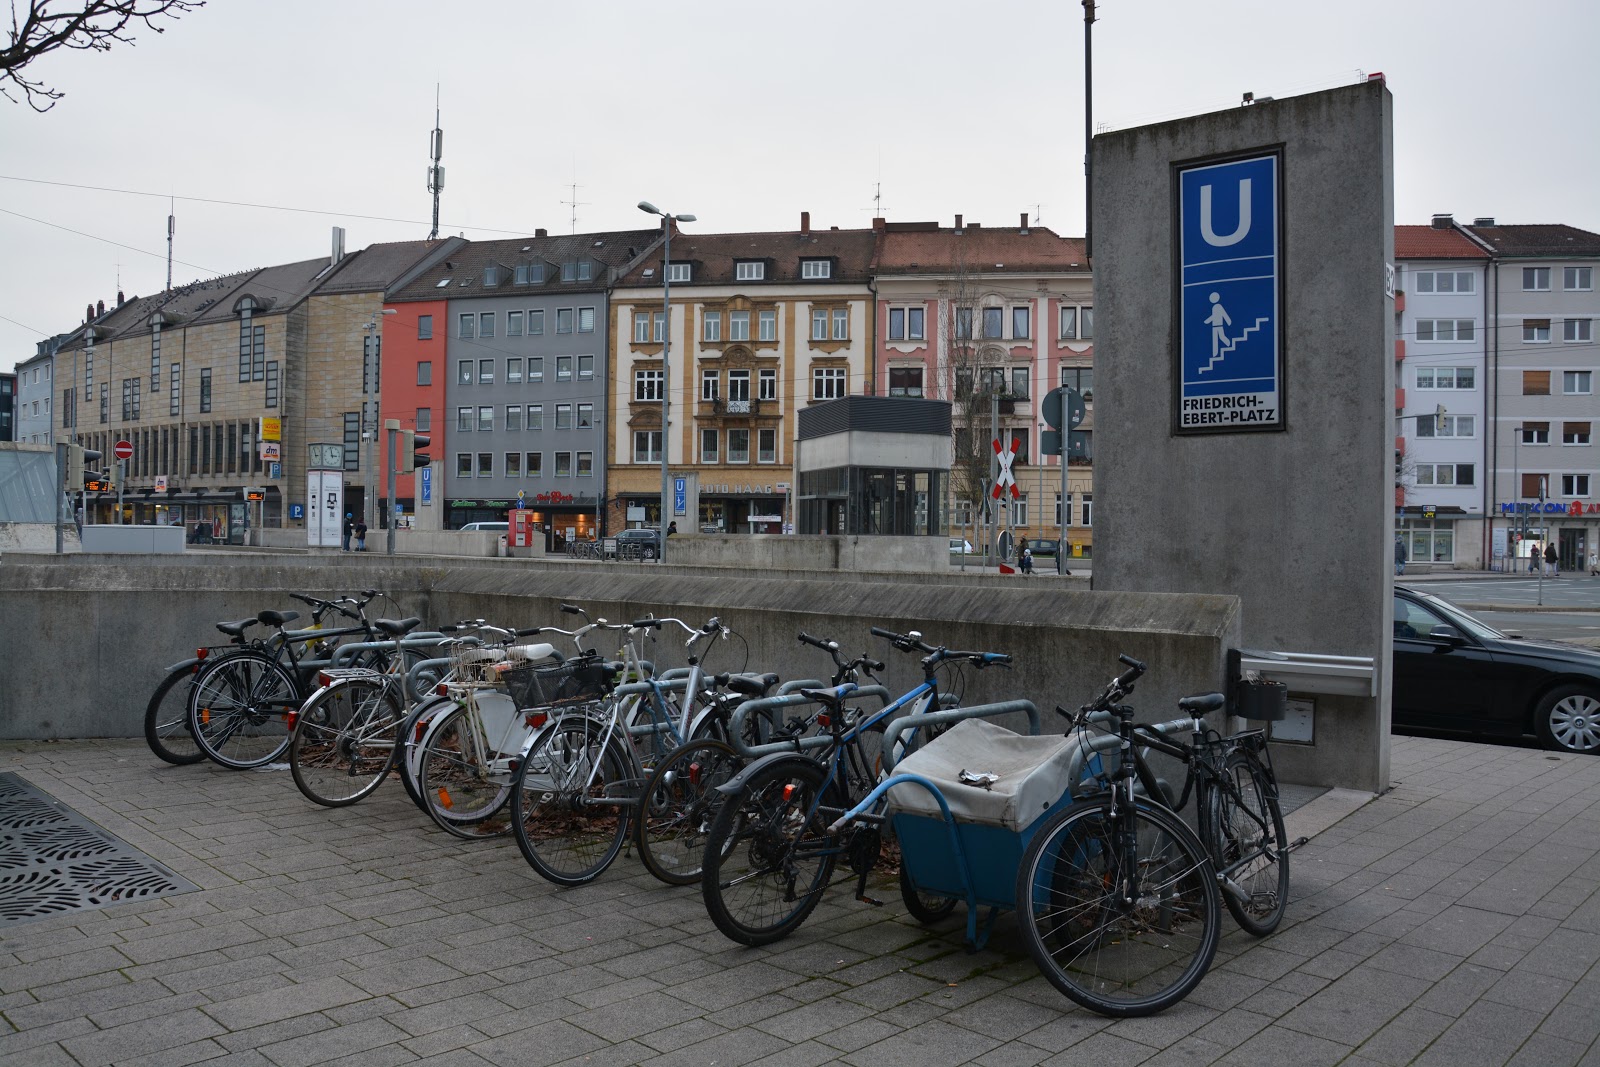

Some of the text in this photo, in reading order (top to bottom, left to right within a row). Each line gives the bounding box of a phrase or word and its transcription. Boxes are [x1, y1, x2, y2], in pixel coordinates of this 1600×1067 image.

[1201, 178, 1252, 247] U
[1184, 395, 1264, 411] FRIEDRICH-
[1184, 409, 1275, 425] EBERT-PLATZ
[266, 446, 277, 454] dm
[273, 464, 279, 473] P
[423, 470, 430, 481] U
[676, 480, 684, 491] U
[698, 484, 772, 494] FOTO HAAG
[294, 505, 301, 515] P
[1501, 502, 1566, 513] MEICON
